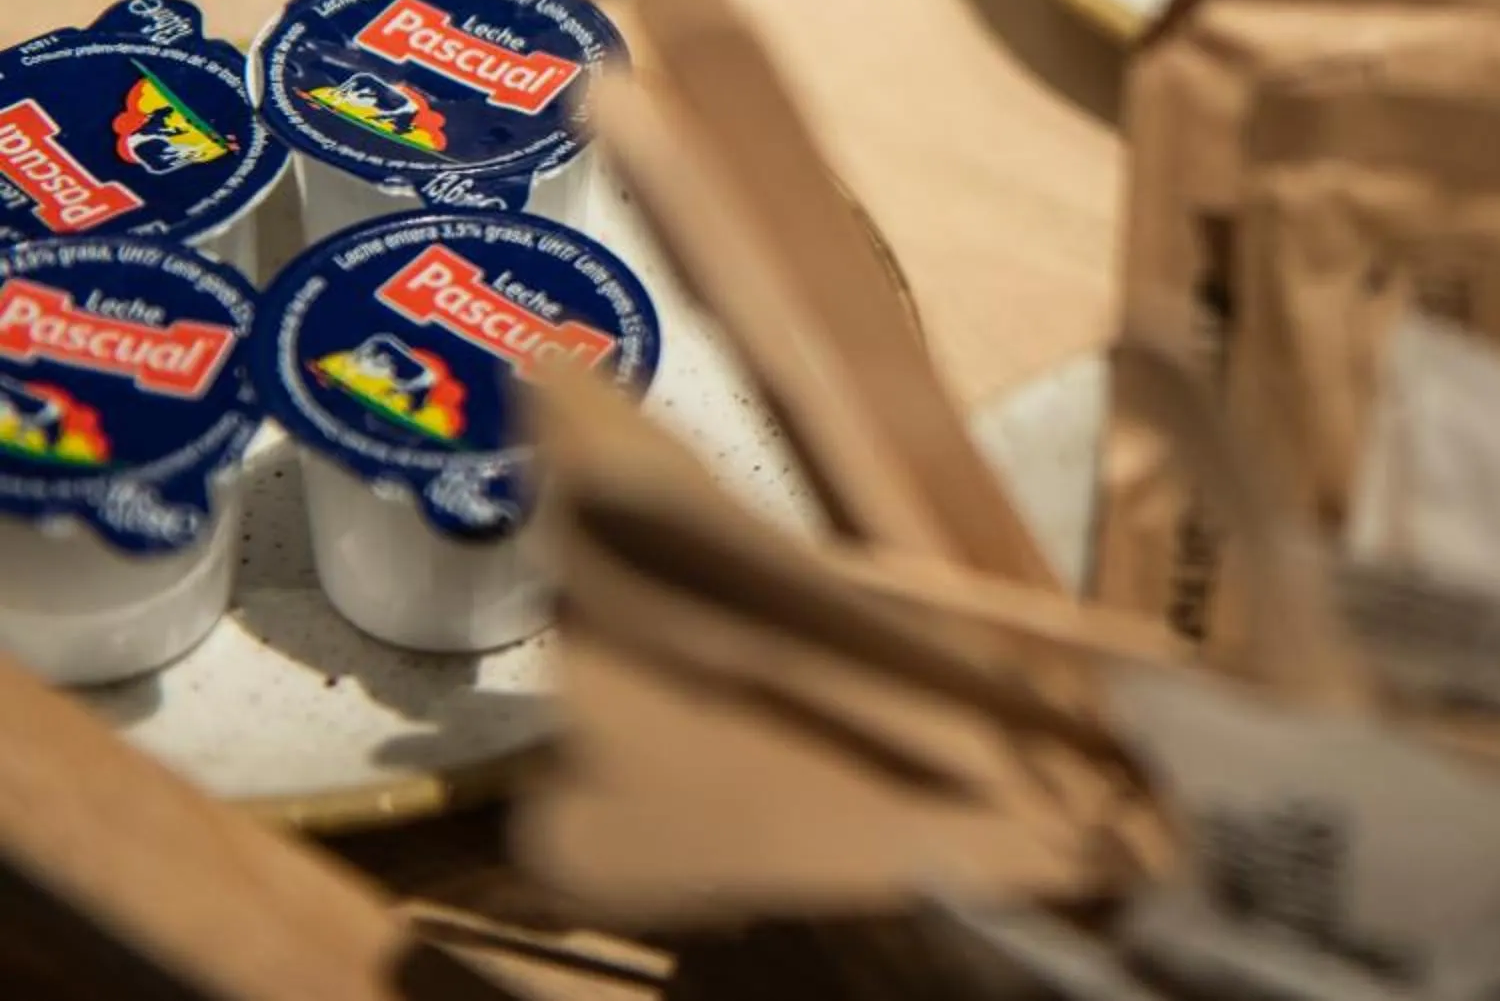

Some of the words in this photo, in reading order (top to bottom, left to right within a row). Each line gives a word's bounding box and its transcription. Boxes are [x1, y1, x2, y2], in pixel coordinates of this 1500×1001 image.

[381, 7, 558, 95] Pascual
[461, 14, 527, 51] Leche
[85, 288, 167, 326] Leche
[491, 269, 563, 319] Leche
[0, 295, 208, 375] Pascual
